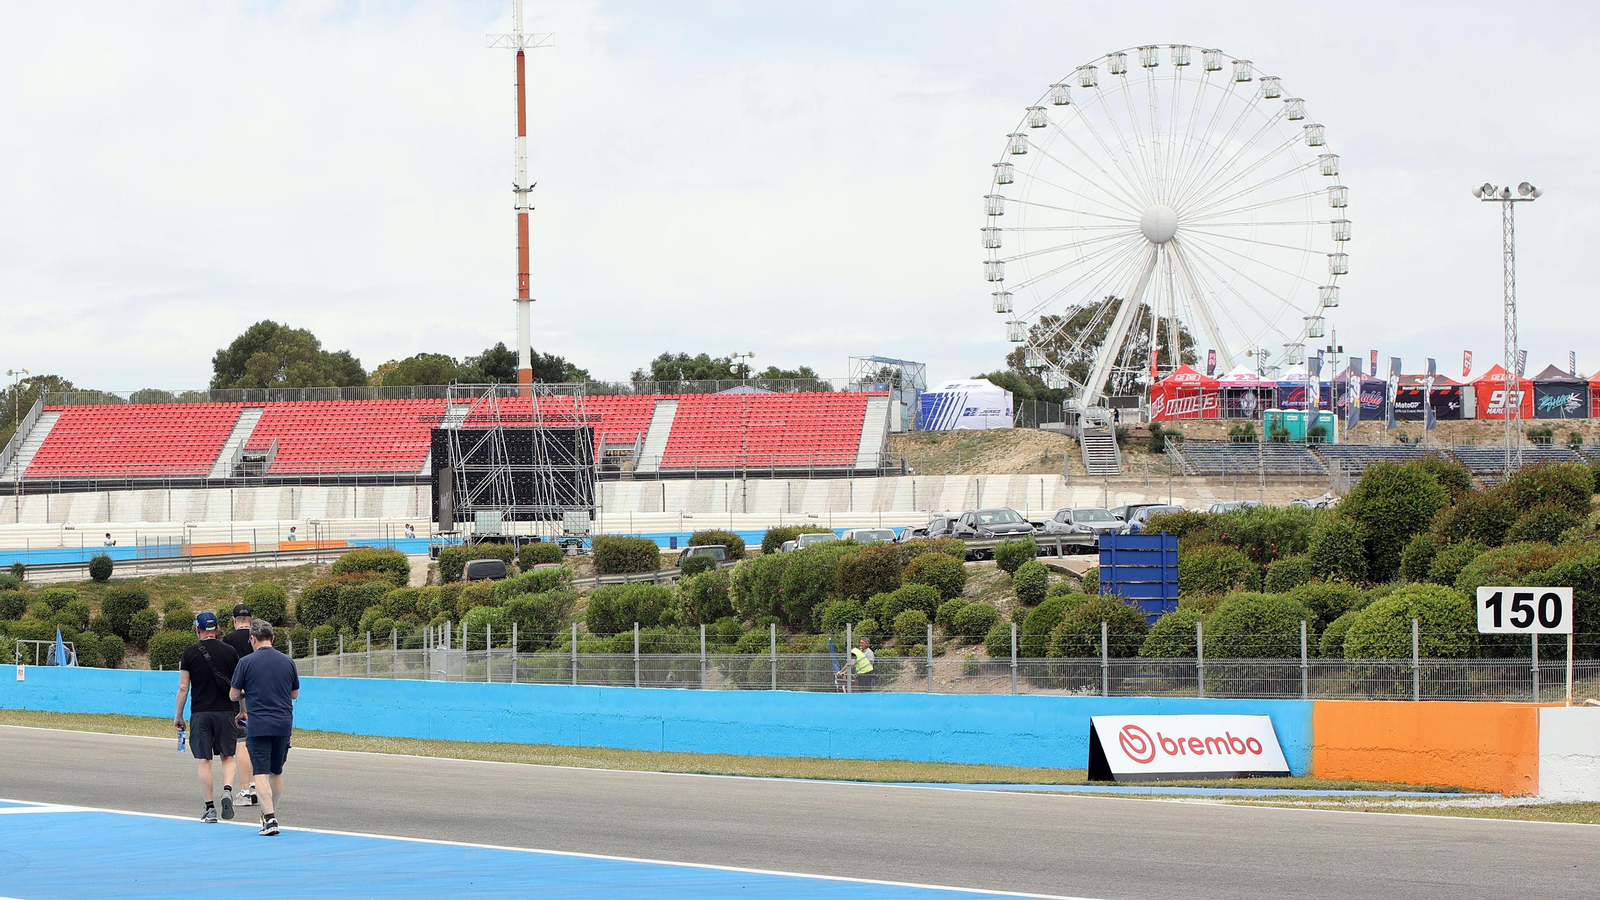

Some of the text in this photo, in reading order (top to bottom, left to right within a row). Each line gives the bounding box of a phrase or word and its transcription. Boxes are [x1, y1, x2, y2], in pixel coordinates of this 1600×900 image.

[1233, 373, 1258, 381] 23
[1488, 390, 1525, 408] 93
[1486, 592, 1562, 628] 150
[1157, 732, 1262, 756] brembo
